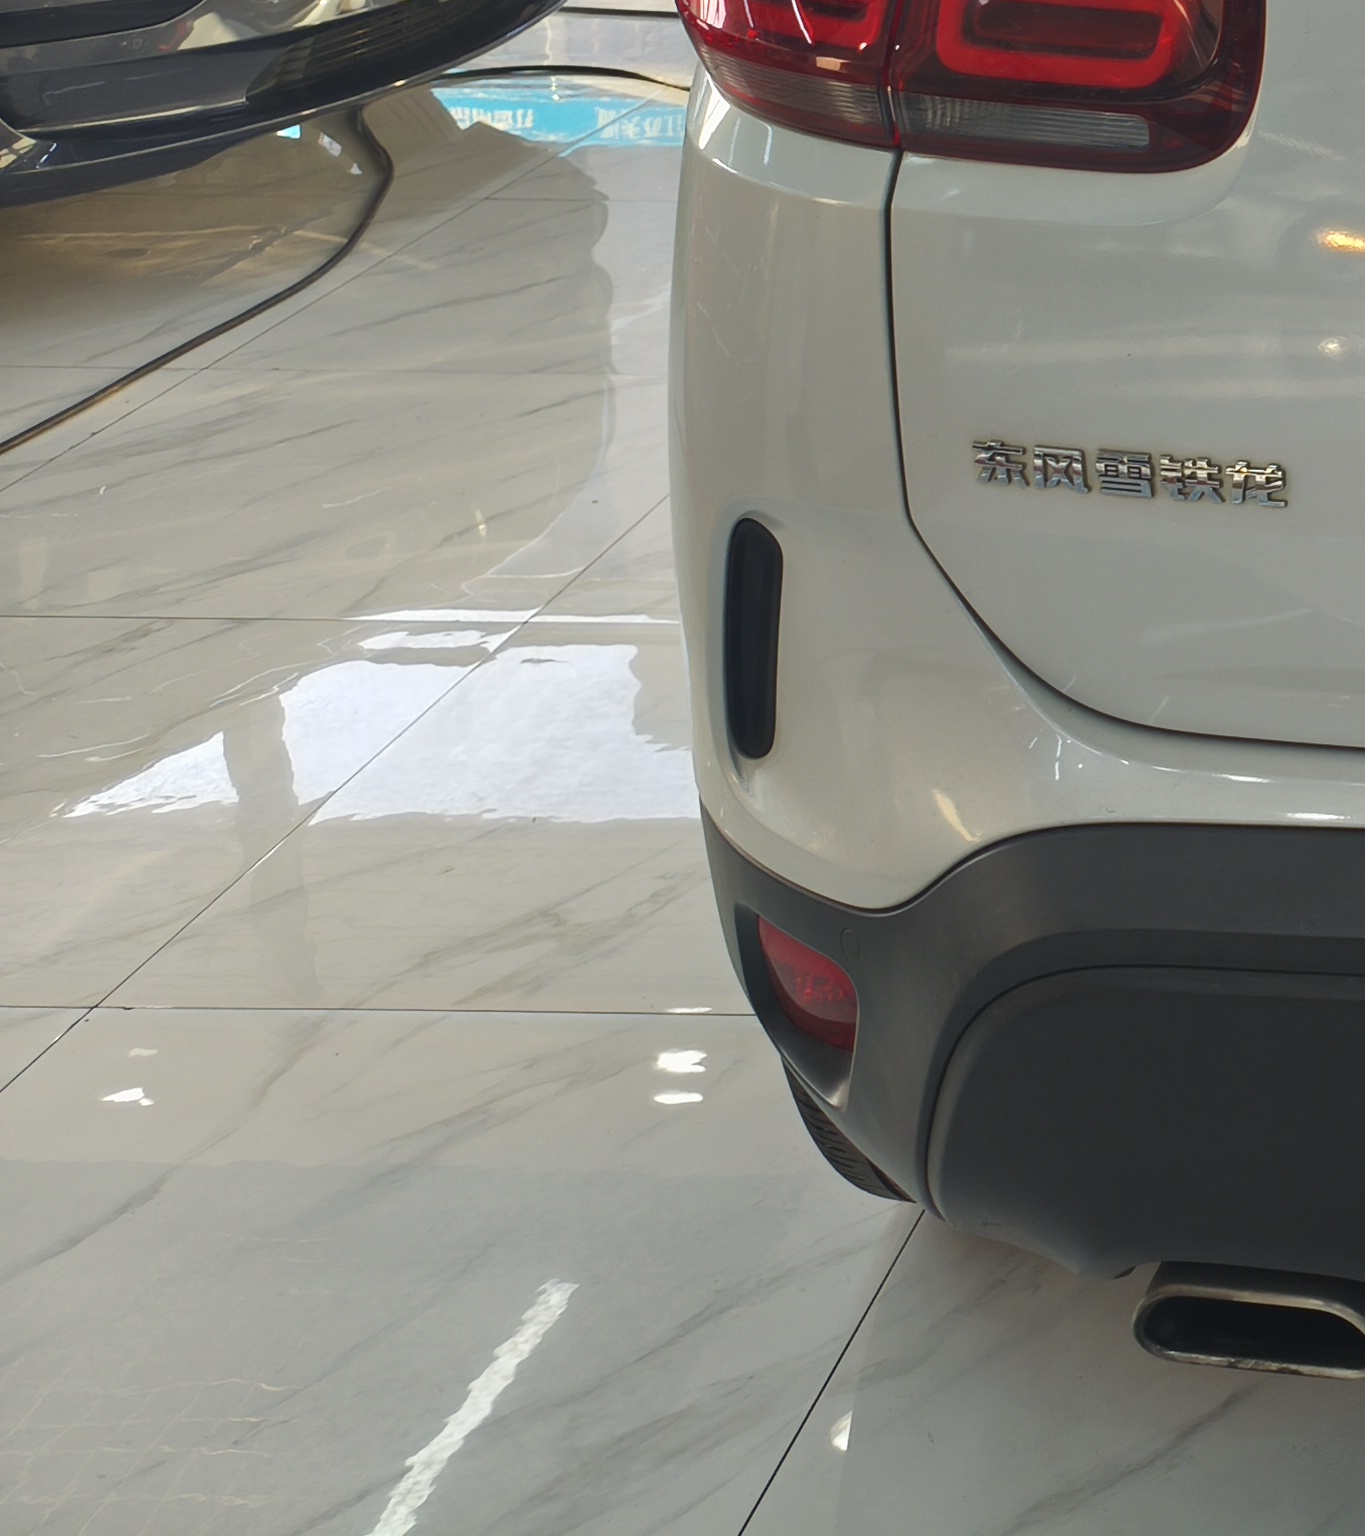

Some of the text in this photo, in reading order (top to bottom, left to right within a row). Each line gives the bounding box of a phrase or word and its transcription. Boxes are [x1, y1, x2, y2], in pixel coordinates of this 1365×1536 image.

[971, 439, 1289, 508] 东风雪铁龙
